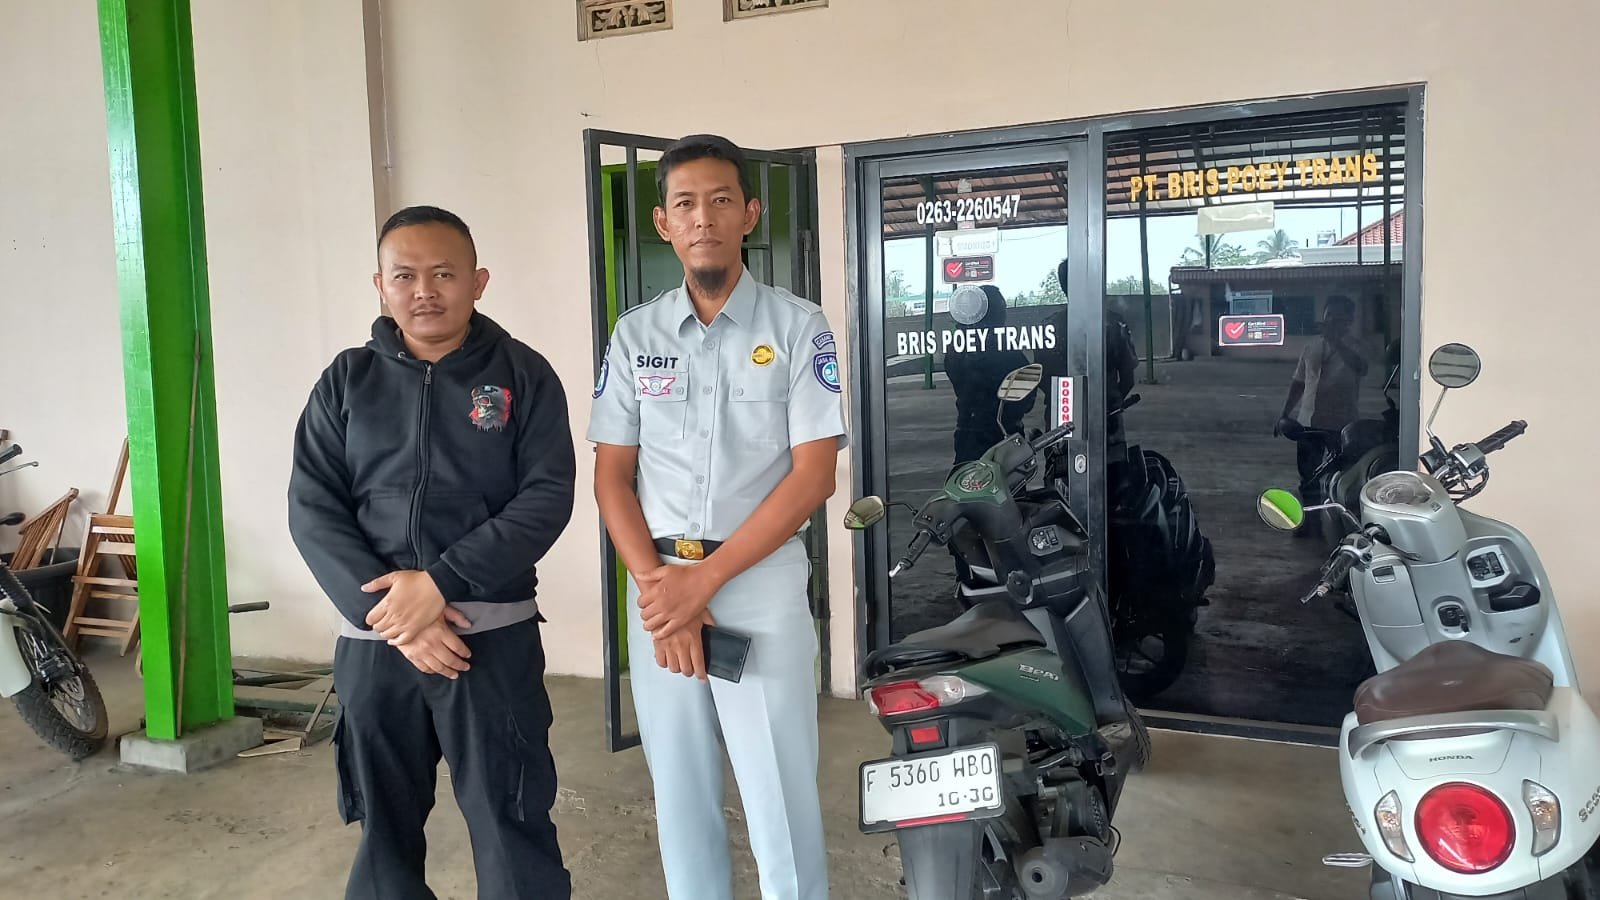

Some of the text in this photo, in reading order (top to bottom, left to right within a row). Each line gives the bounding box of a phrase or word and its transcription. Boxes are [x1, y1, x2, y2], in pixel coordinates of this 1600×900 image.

[1130, 153, 1378, 202] PT. BRIS POEY TRANS
[916, 194, 1021, 224] 0263-2260547
[897, 324, 1056, 355] BRIS POEY TRANS
[636, 355, 679, 369] SIGIT
[1061, 380, 1070, 423] DORON
[1428, 754, 1474, 763] HONDA
[866, 769, 877, 793] F
[890, 760, 940, 788] 5360
